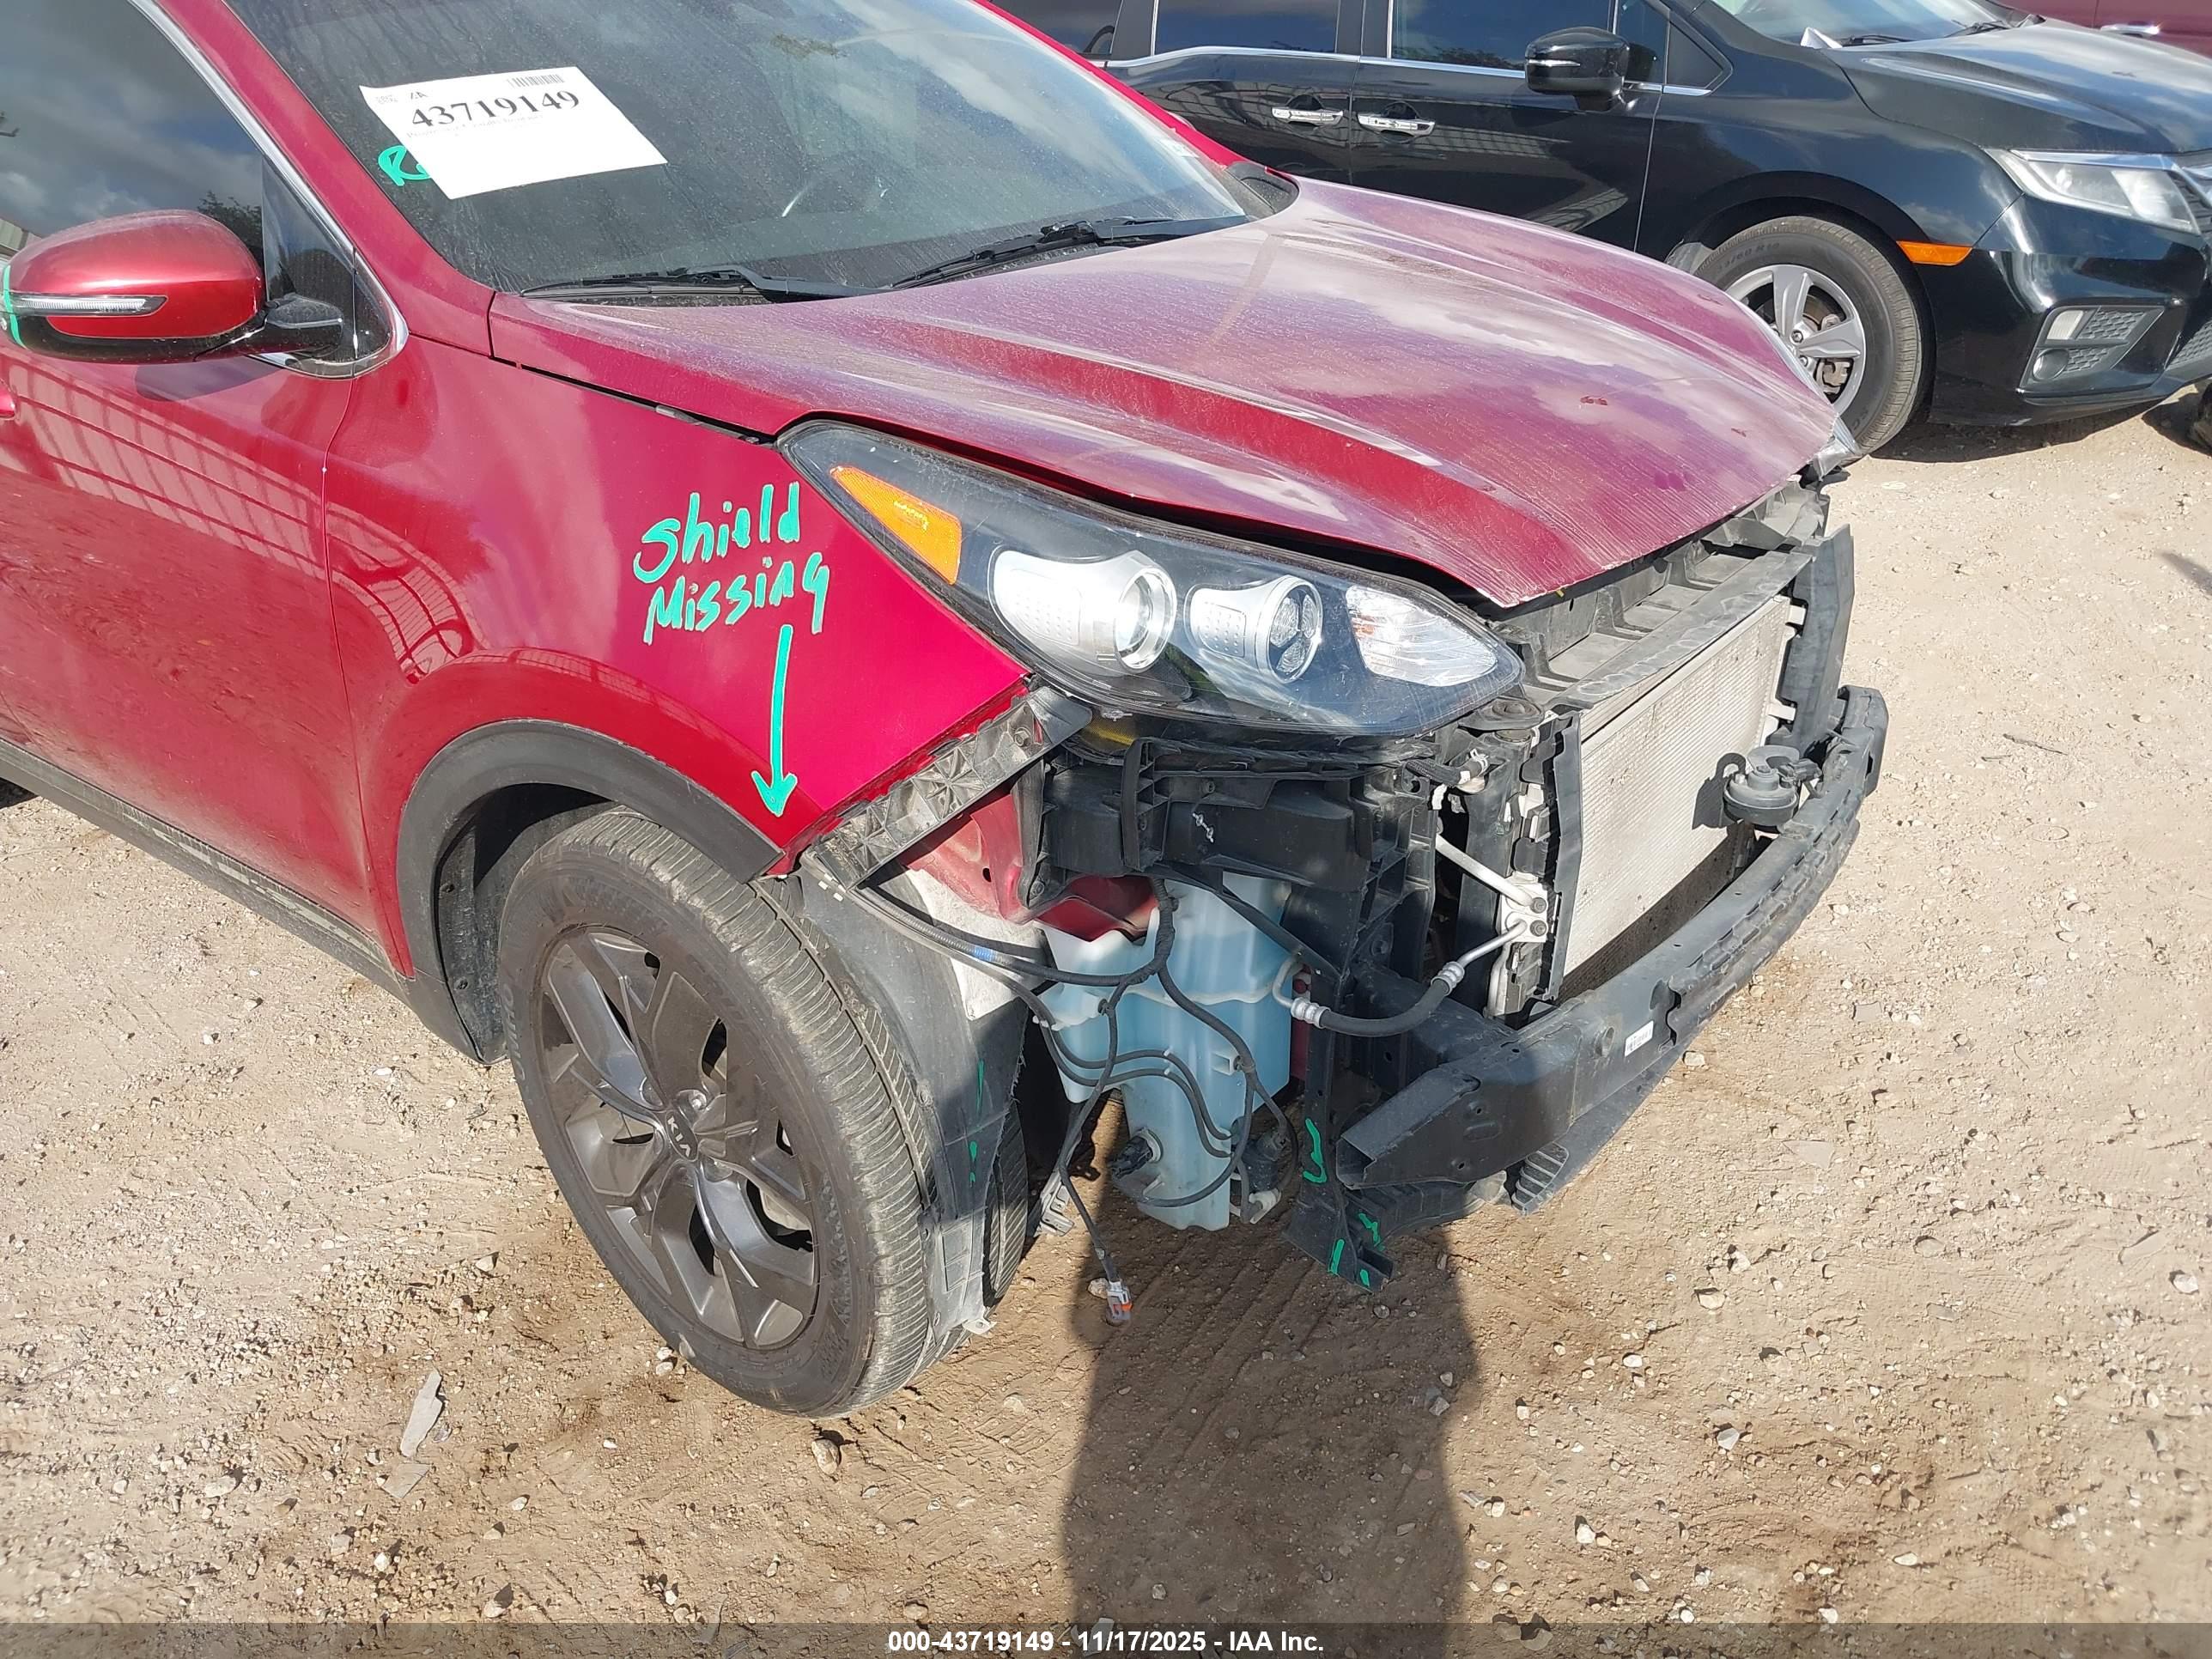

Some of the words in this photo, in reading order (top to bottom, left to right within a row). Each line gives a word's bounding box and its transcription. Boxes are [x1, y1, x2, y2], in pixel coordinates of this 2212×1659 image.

[411, 89, 581, 128] 43719149
[643, 551, 830, 646] Missing
[666, 1115, 692, 1158] KIA
